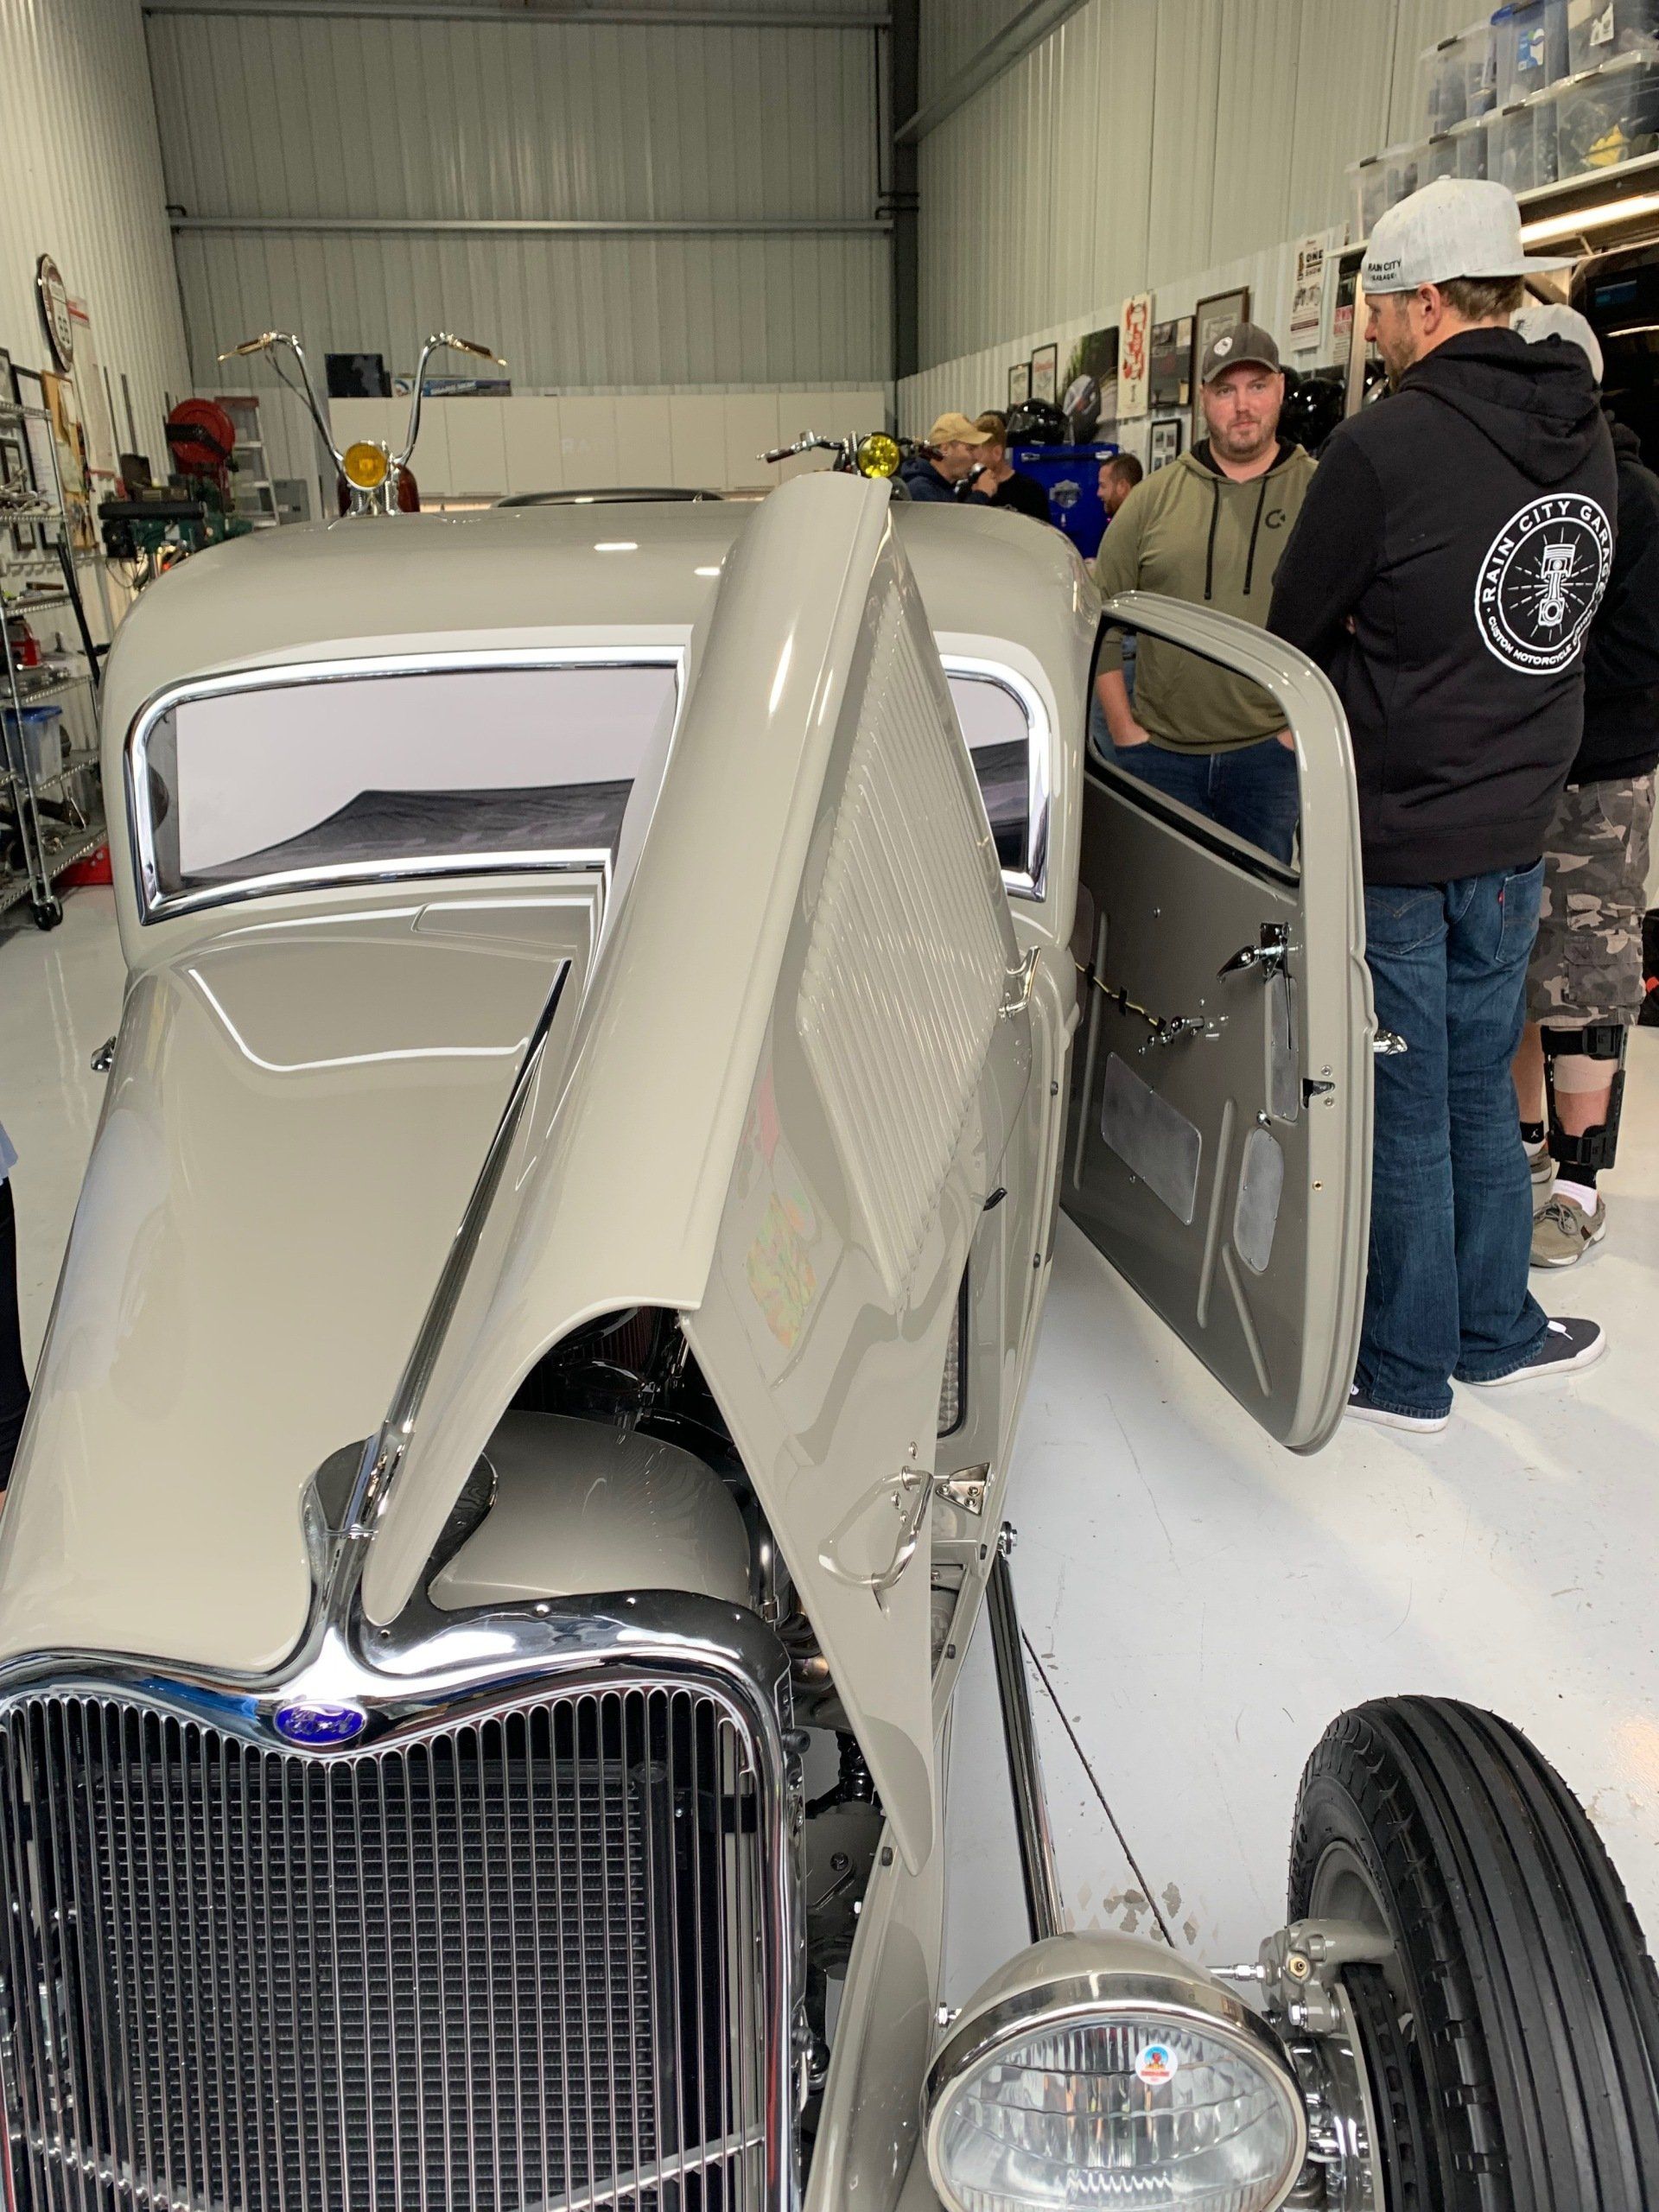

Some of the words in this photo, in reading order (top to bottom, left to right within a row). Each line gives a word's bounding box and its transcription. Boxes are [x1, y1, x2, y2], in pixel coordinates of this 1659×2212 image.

[1306, 250, 1324, 263] ONE
[1368, 263, 1382, 271] RAIN
[1383, 258, 1402, 270] CITY
[1482, 537, 1515, 603] RAIN
[1519, 501, 1570, 532] CITY
[1489, 616, 1515, 653] CUSTOM
[1513, 644, 1573, 665] MOTORCYCLE
[1573, 609, 1593, 647] DSIGN
